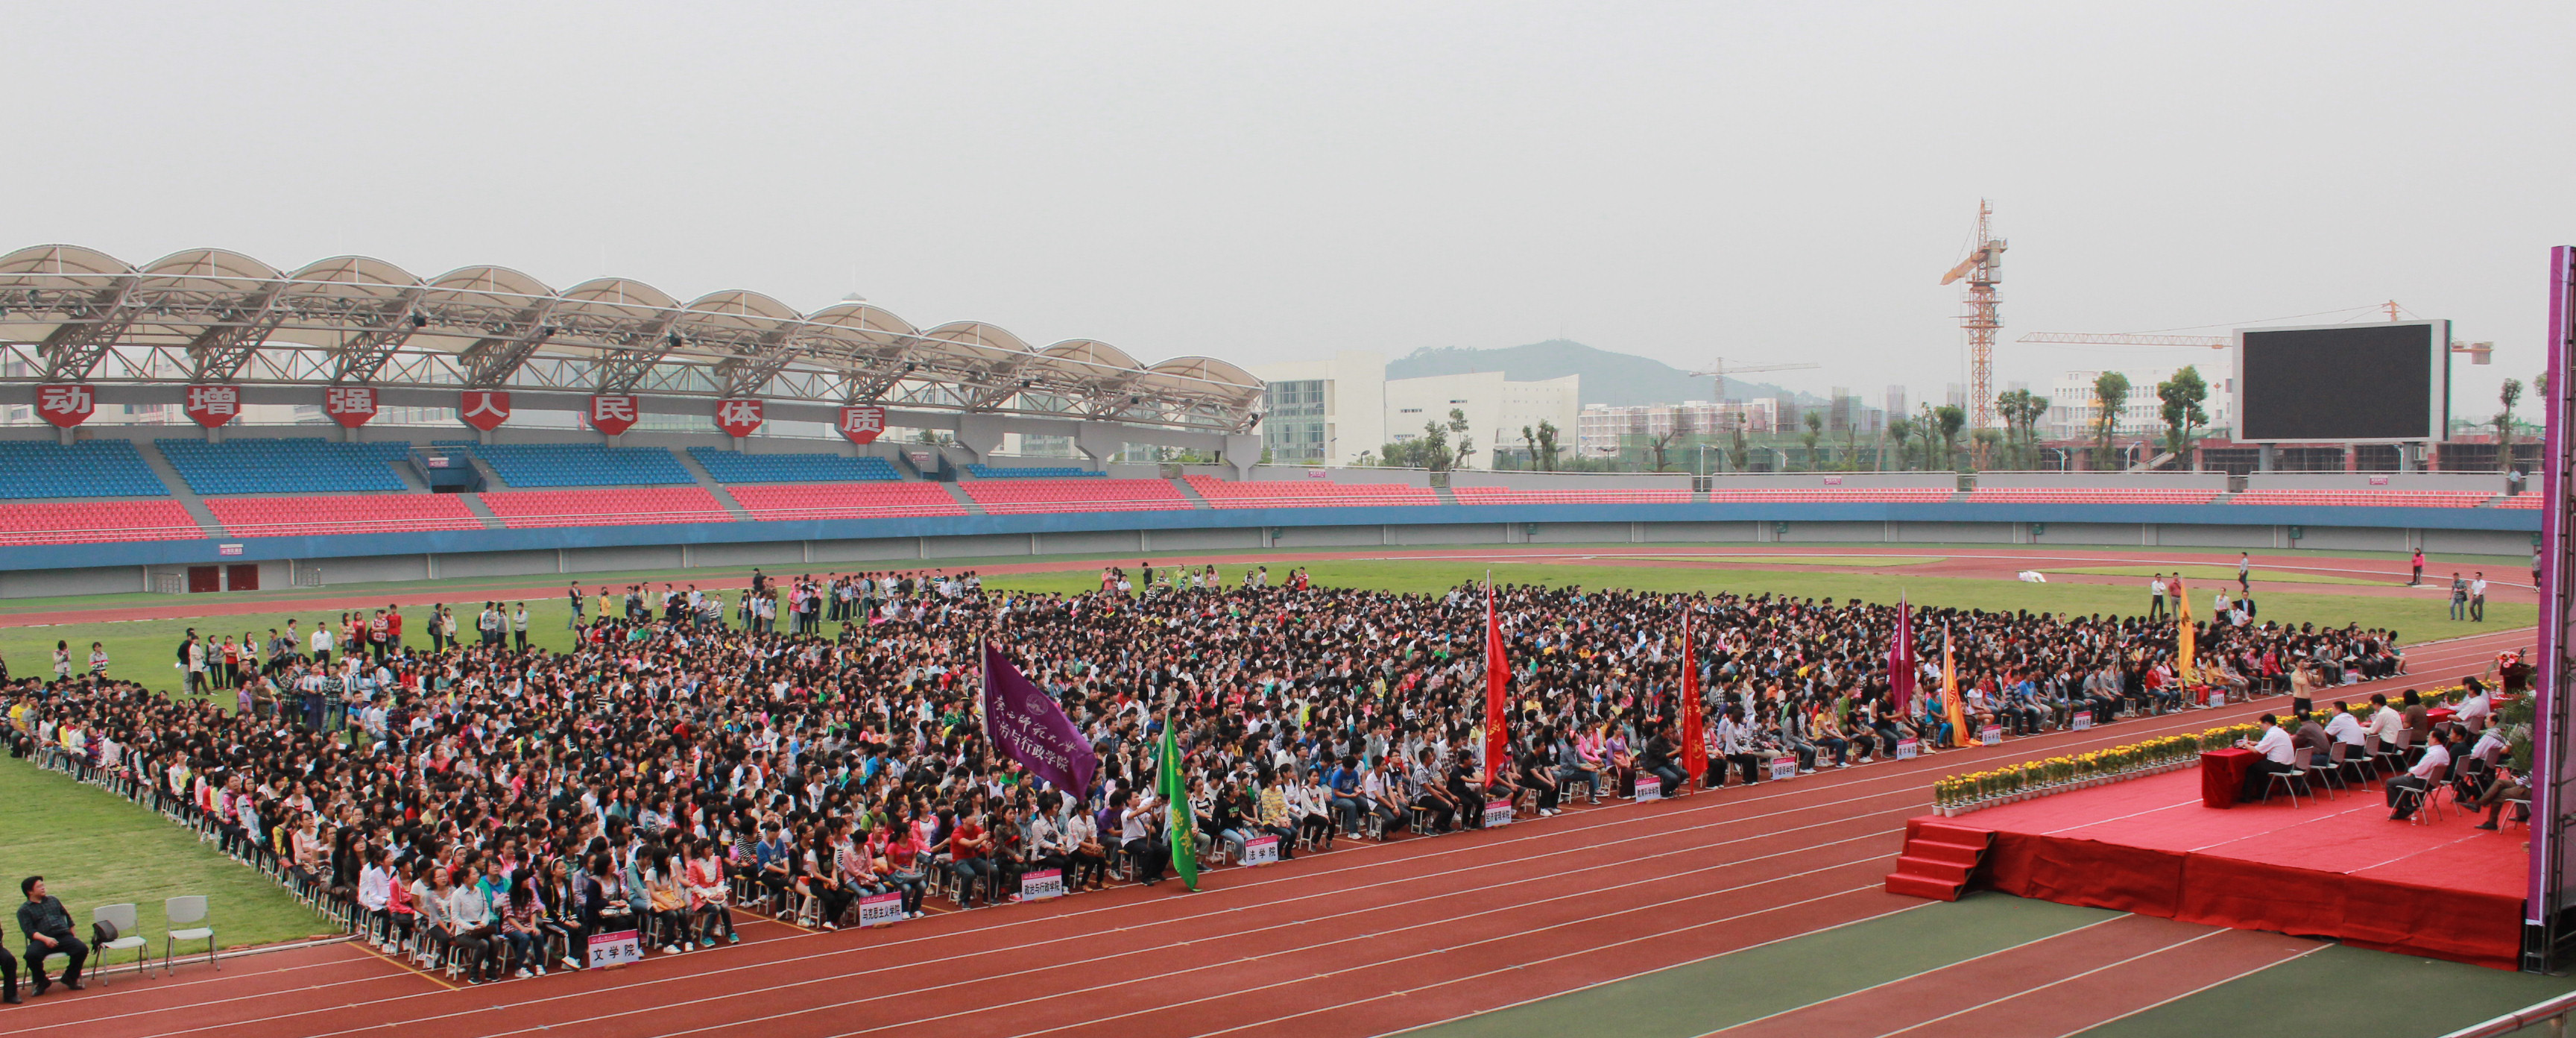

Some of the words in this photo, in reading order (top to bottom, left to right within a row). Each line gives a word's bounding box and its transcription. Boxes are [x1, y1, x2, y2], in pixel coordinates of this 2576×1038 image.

[42, 387, 90, 415] 动
[189, 389, 236, 415] 增
[329, 389, 376, 415] 强
[464, 393, 508, 418] 人
[596, 397, 634, 422] 民
[719, 401, 760, 427] 体
[844, 409, 883, 433] 质
[996, 716, 1069, 773] 治与行政学院
[1486, 810, 1510, 822] 经济管理学院
[1248, 846, 1276, 861] 法学院
[1024, 880, 1060, 895] 政治与行政学院
[862, 904, 900, 920] 马克思主义学院
[593, 943, 635, 961] 文学院
